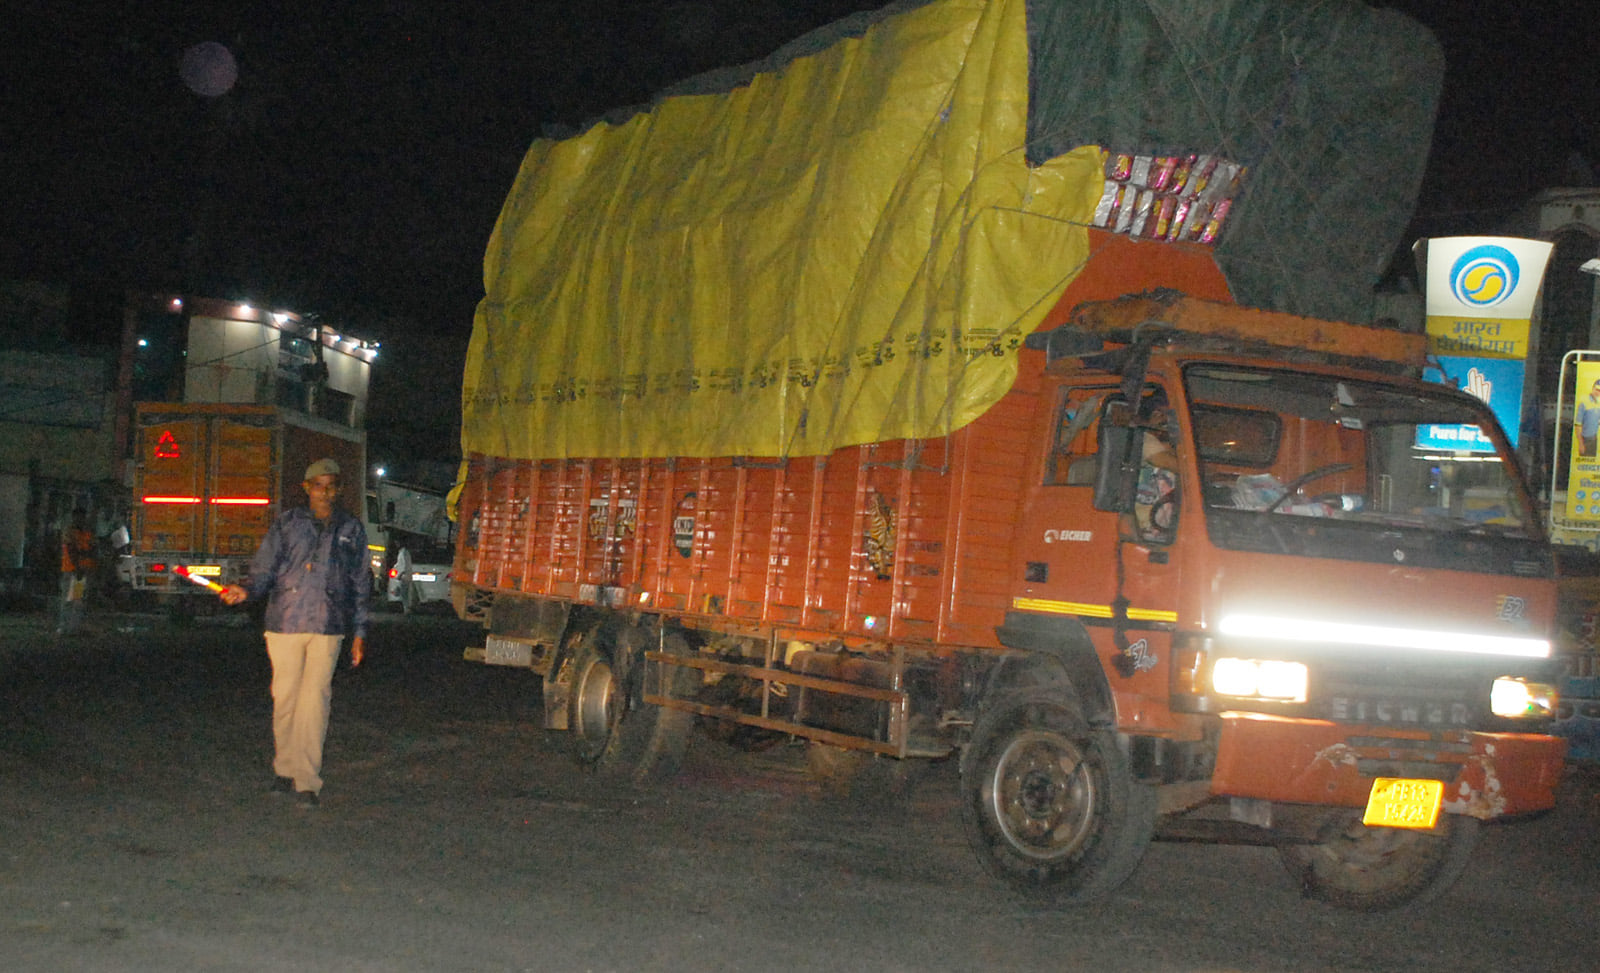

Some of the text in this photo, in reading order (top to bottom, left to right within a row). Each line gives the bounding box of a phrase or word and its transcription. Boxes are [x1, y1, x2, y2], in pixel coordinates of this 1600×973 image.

[1429, 425, 1458, 440] Pure
[1459, 426, 1476, 441] for
[1060, 530, 1093, 541] EICHER
[1332, 697, 1467, 725] EICHER
